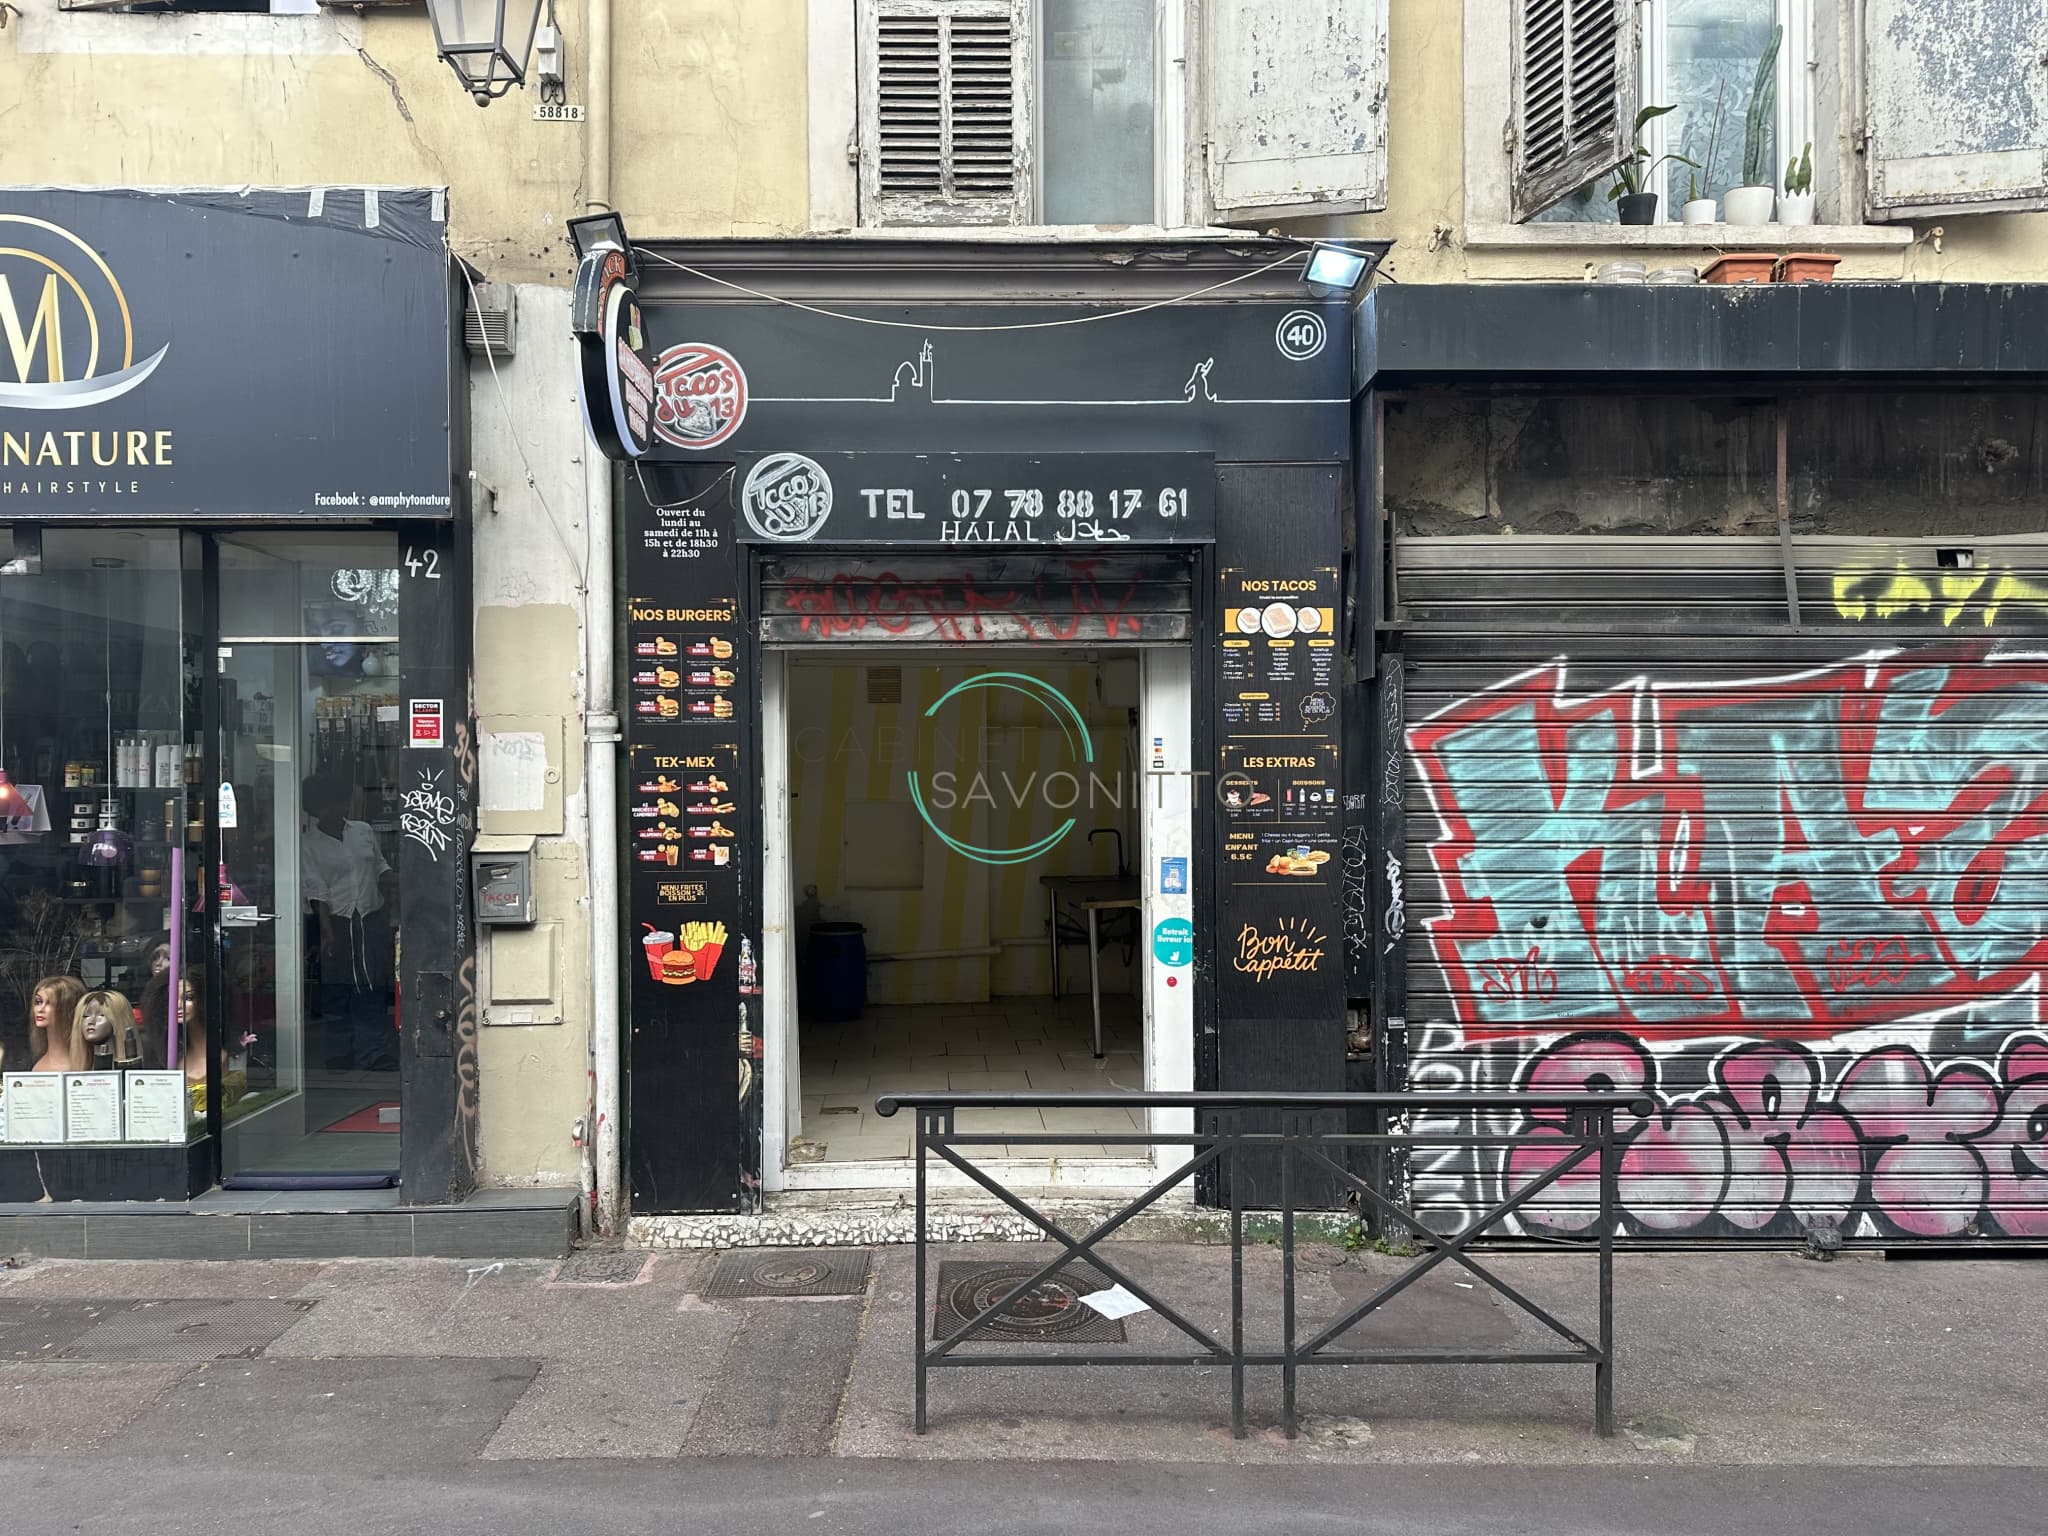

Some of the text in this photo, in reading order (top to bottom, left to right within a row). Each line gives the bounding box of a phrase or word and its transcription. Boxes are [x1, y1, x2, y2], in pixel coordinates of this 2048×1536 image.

[540, 106, 578, 118] 58818
[1287, 325, 1314, 346] 40
[657, 397, 735, 422] du 13
[2, 430, 173, 466] NATURE
[3, 481, 139, 494] HAIRSTYLE
[315, 493, 359, 506] Facebook
[369, 493, 450, 509] @amphytonature
[860, 488, 1187, 519] TEL 07 78 88 17 61
[656, 508, 706, 517] Ouvert du
[661, 518, 687, 527] lundi
[644, 528, 719, 537] samedi de 11h à
[940, 520, 1039, 542] HALAL
[644, 539, 718, 548] 15h et de 18h30
[662, 549, 700, 558] à 22h30
[404, 545, 441, 580] 42
[1241, 580, 1318, 592] NOS TACOS
[633, 609, 731, 621] NOS BURGERS
[653, 756, 716, 768] TEX-MEX
[1243, 756, 1316, 768] LES EXTRAS
[1162, 927, 1189, 935] Retrait
[1157, 935, 1183, 943] livreur
[1237, 923, 1296, 959] Bon
[1233, 948, 1325, 983] appétit
